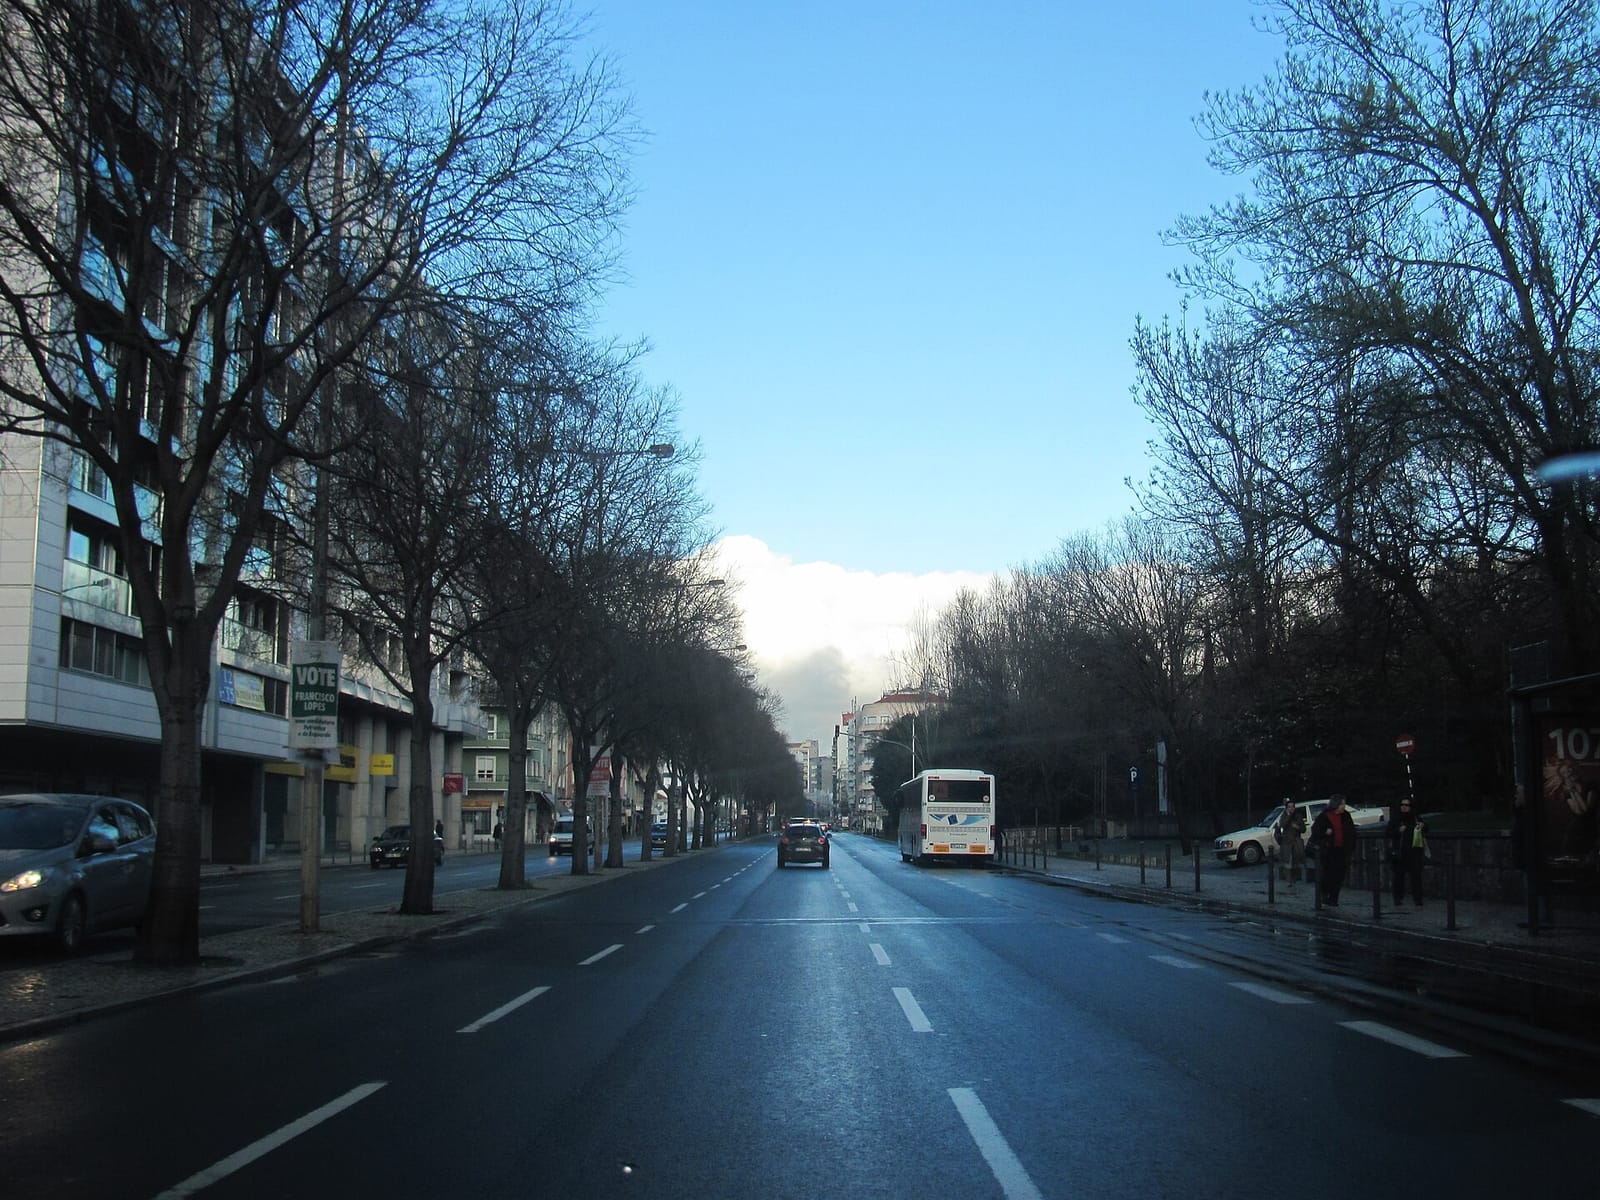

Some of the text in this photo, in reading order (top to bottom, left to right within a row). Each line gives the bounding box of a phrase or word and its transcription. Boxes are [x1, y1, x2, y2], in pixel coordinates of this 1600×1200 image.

[296, 667, 336, 687] VOTE
[295, 691, 335, 703] FRANCISCO
[304, 702, 326, 711] LOPES
[1131, 771, 1137, 782] P
